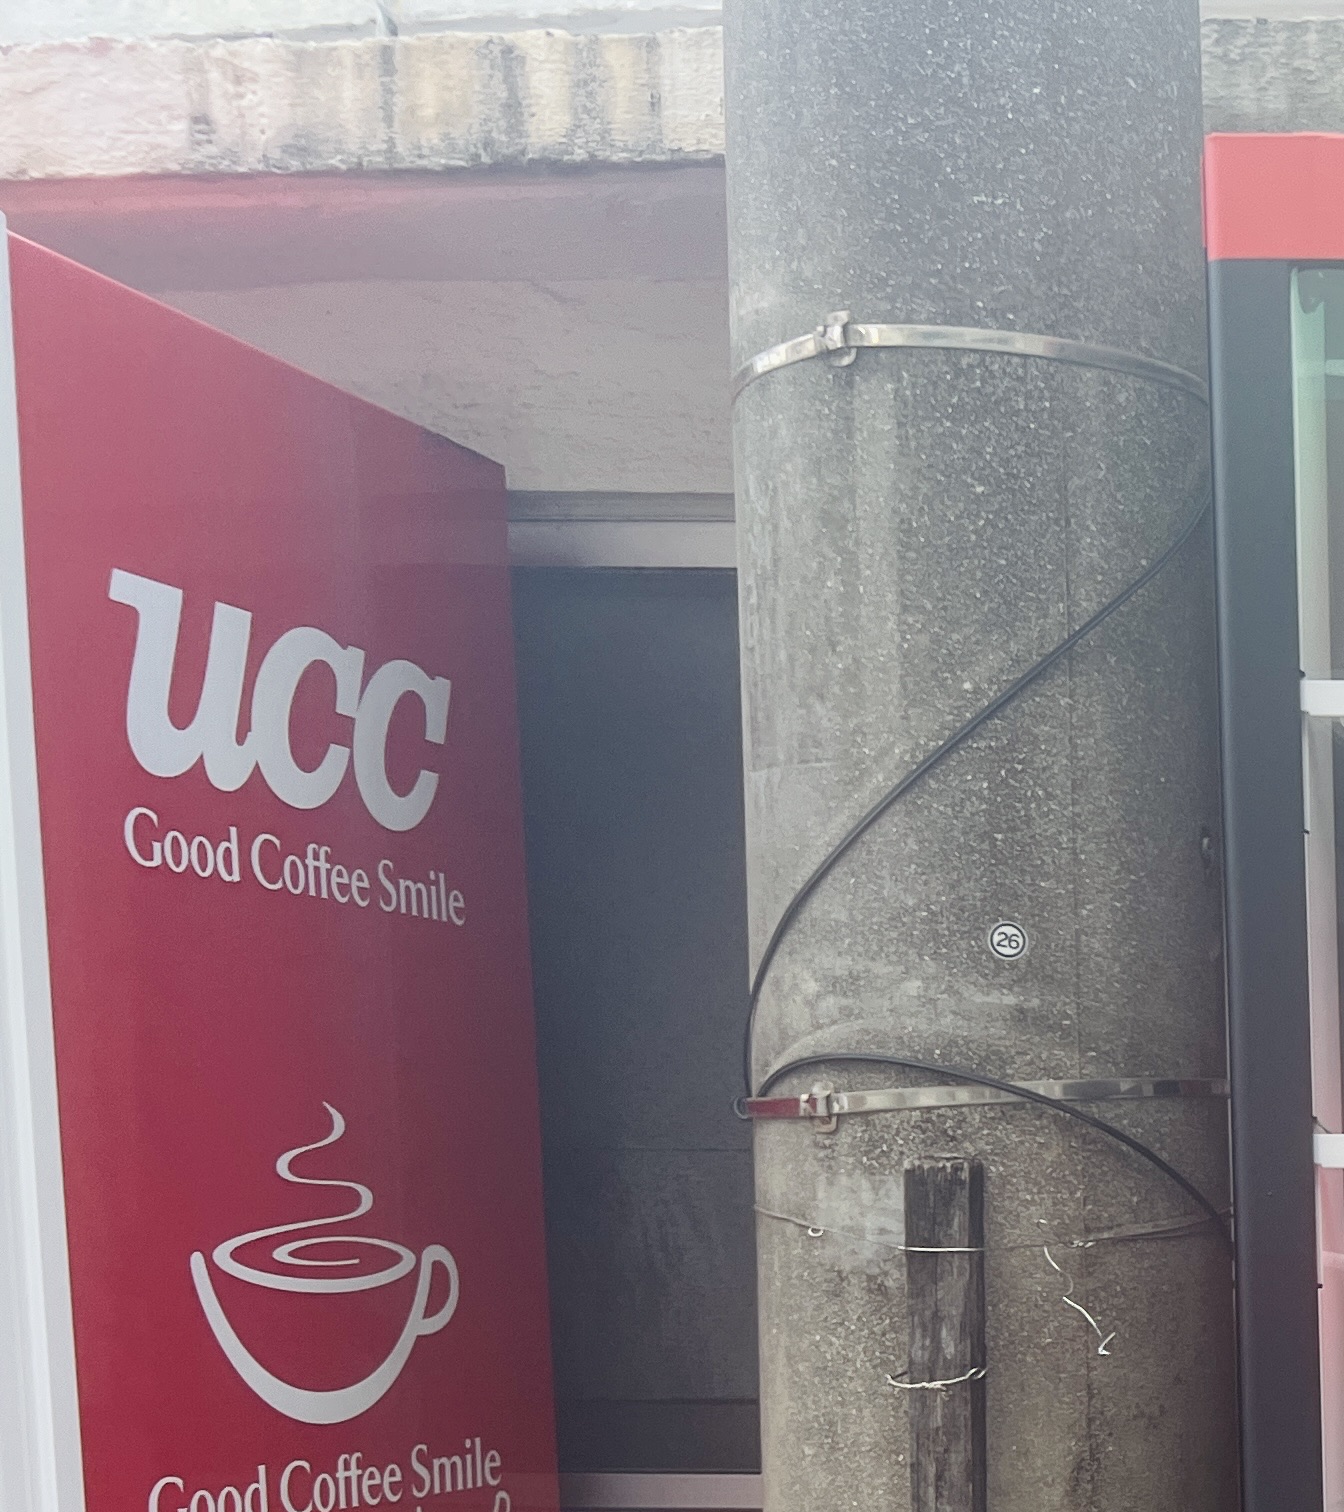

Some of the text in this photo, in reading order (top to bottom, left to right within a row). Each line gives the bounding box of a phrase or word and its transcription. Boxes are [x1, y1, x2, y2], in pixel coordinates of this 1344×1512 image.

[124, 807, 466, 926] Good Coffee Smile
[996, 931, 1020, 949] 26
[410, 1436, 501, 1497] Smile
